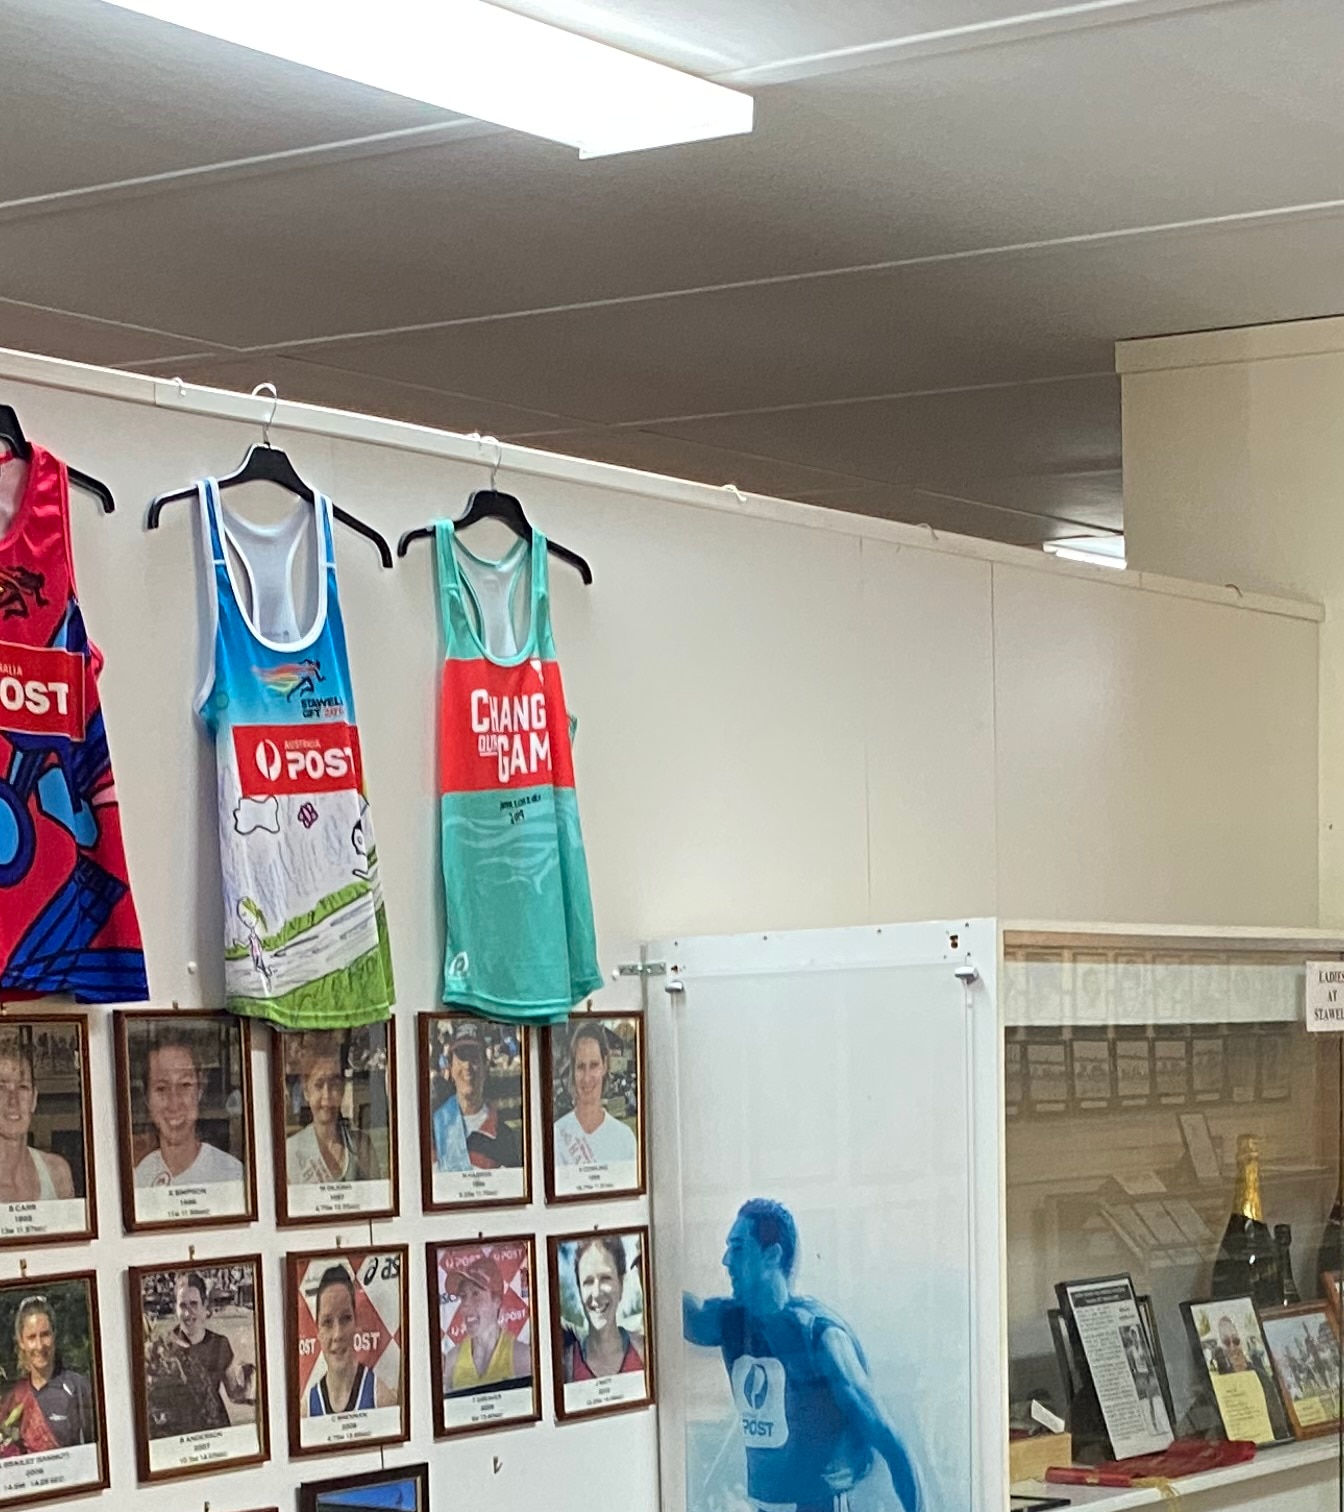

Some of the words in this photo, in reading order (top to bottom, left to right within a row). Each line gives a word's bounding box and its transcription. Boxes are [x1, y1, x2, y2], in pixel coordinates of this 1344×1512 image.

[471, 688, 547, 734] CHANG
[284, 739, 321, 750] AUSTRALIA
[496, 732, 553, 784] GAM
[1327, 990, 1338, 1003] AT
[353, 1331, 380, 1352] OST
[742, 1419, 774, 1438] POST
